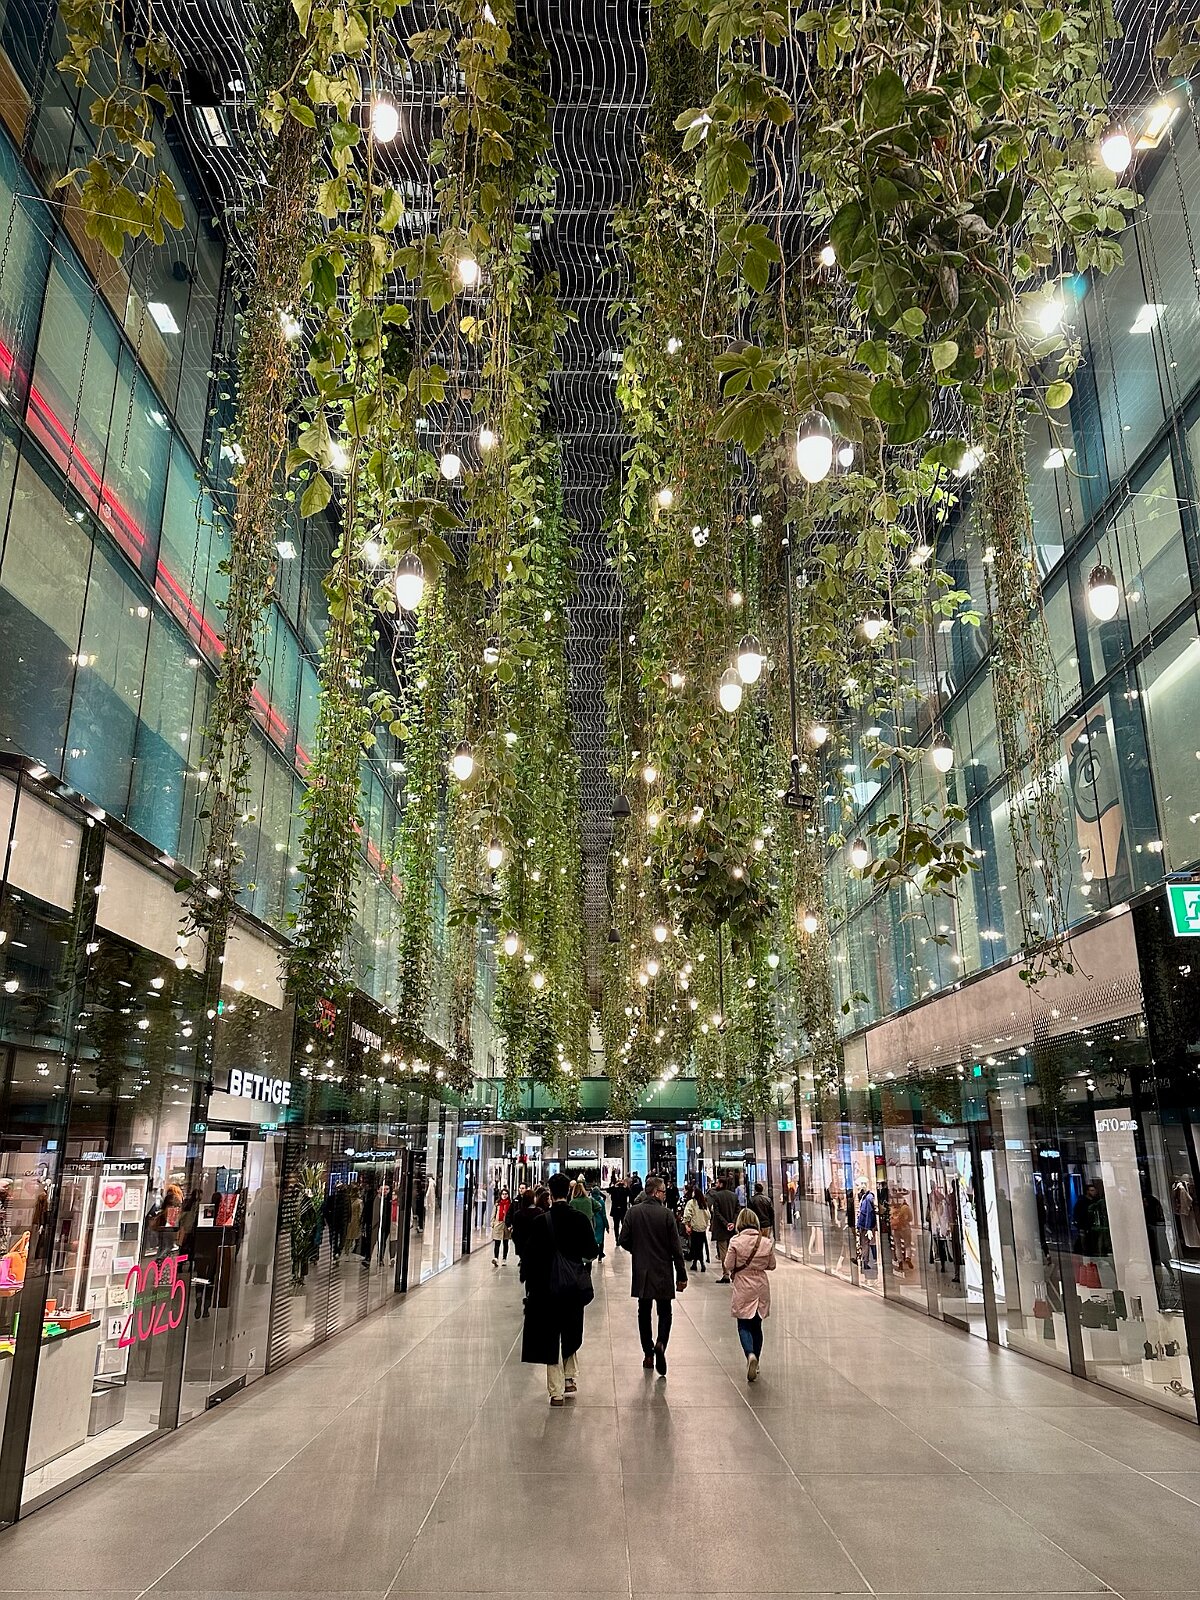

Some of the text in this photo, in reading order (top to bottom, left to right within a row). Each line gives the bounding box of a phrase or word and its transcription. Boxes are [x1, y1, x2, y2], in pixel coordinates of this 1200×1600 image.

[229, 1068, 291, 1105] BETHGE
[103, 1163, 144, 1171] BETHGE
[117, 1253, 189, 1349] 2025
